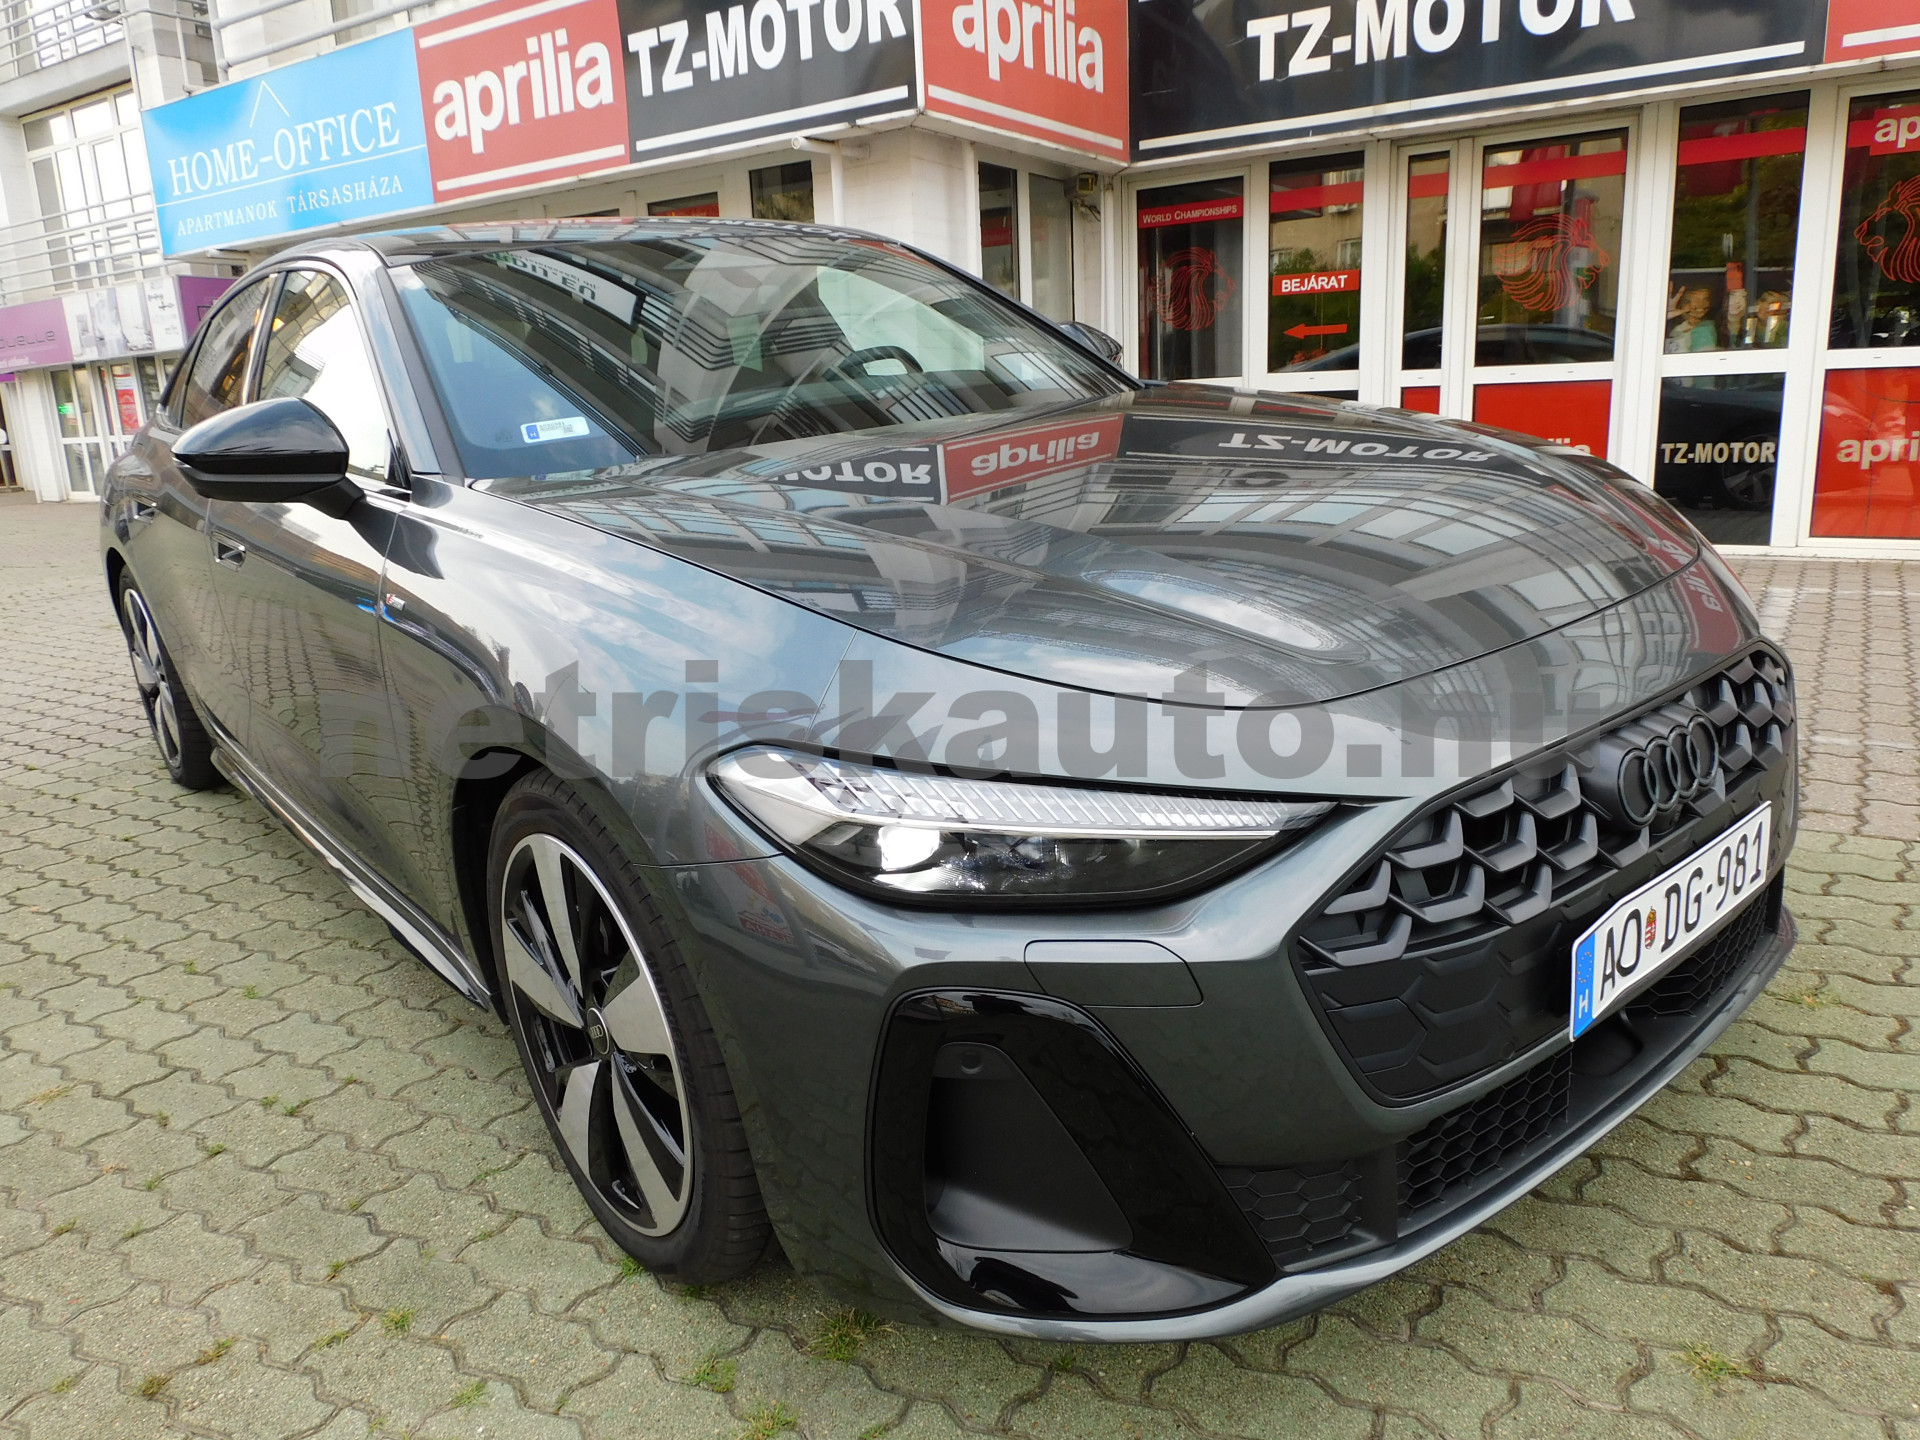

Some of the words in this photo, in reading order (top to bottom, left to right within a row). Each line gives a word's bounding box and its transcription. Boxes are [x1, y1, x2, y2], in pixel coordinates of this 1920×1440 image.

[433, 27, 615, 155] aprilia
[628, 0, 907, 97] TZ-MOTOR
[952, 0, 1104, 94] aprilia
[167, 102, 401, 197] HOME-OFFICE
[177, 200, 278, 237] APARTMANOK
[287, 174, 403, 214] TÁRSASHÁZA
[1281, 275, 1348, 293] BEJÁRAT
[1660, 441, 1777, 464] TZ-MOTOR
[1600, 908, 1642, 1001] AO
[1660, 821, 1763, 953] DG-981
[1578, 988, 1589, 1019] H
